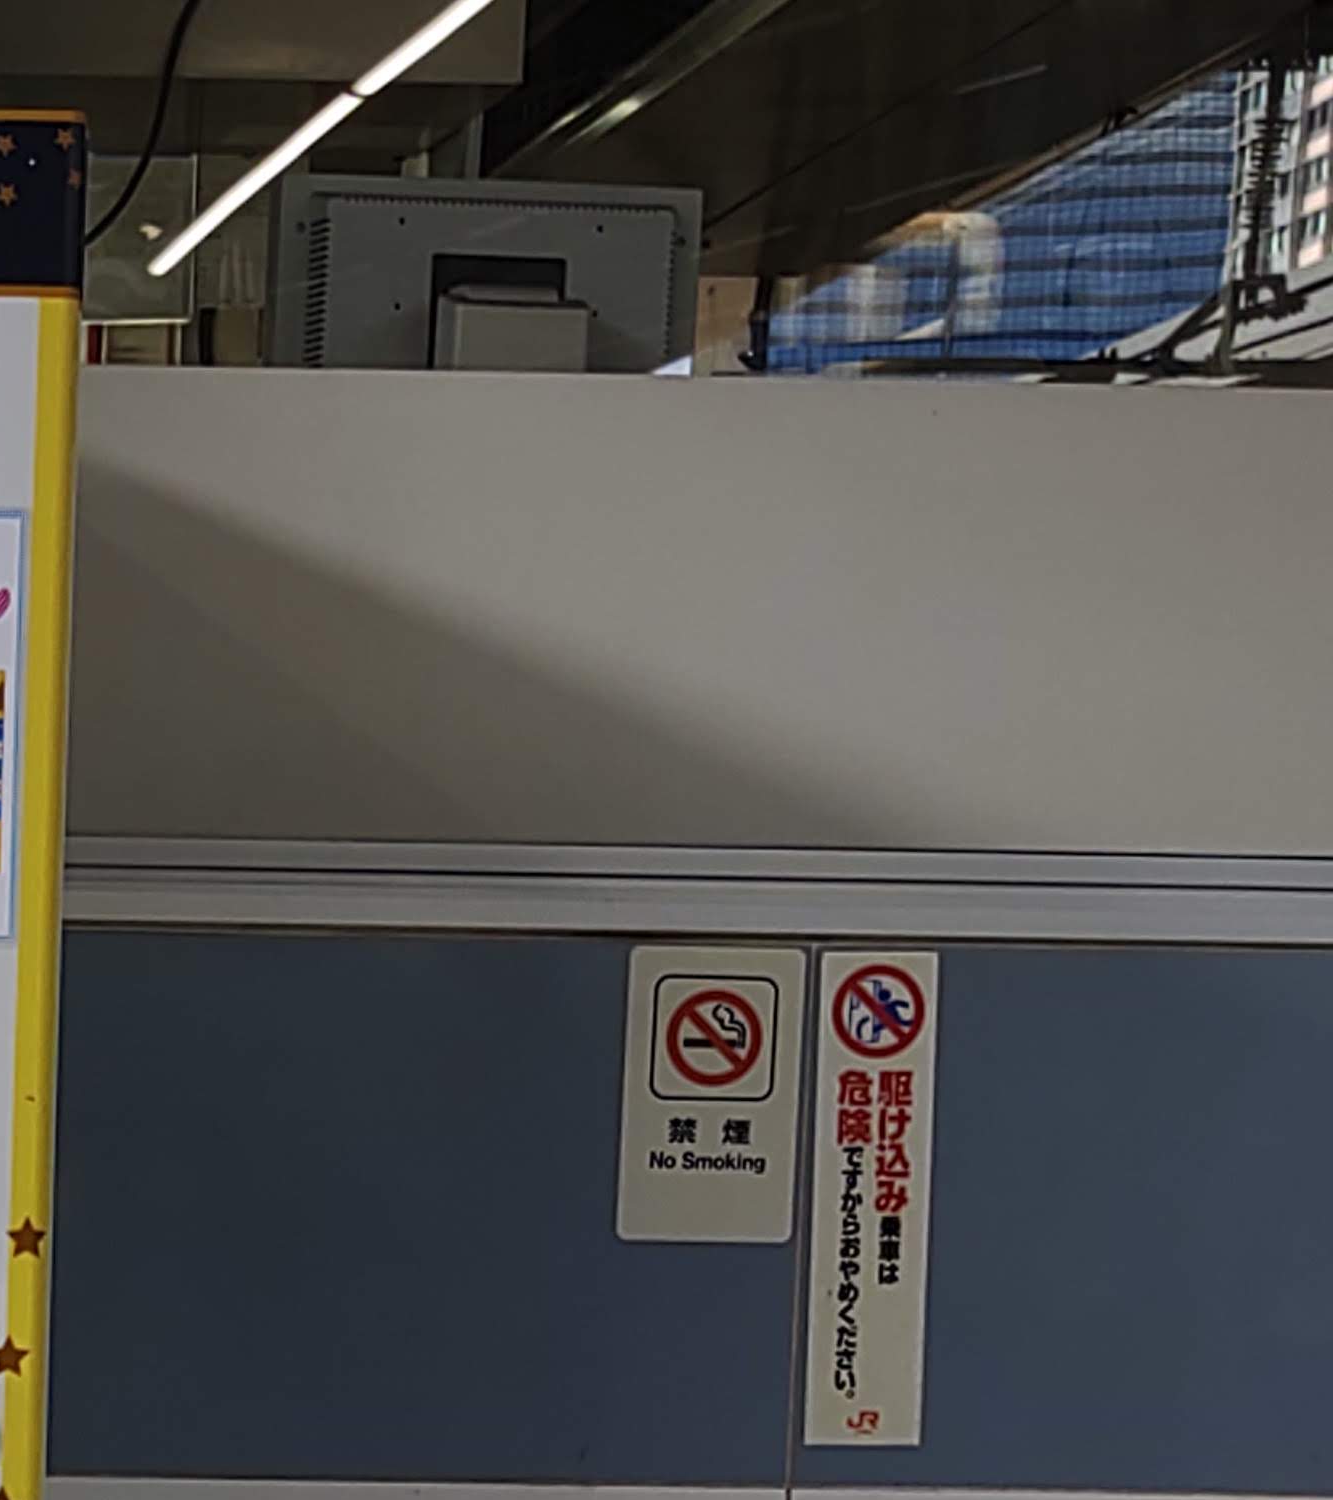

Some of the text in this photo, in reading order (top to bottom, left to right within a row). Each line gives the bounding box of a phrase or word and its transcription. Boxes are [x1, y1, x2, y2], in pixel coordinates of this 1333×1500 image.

[649, 1152, 766, 1175] No Smoking
[847, 1410, 880, 1430] JR
